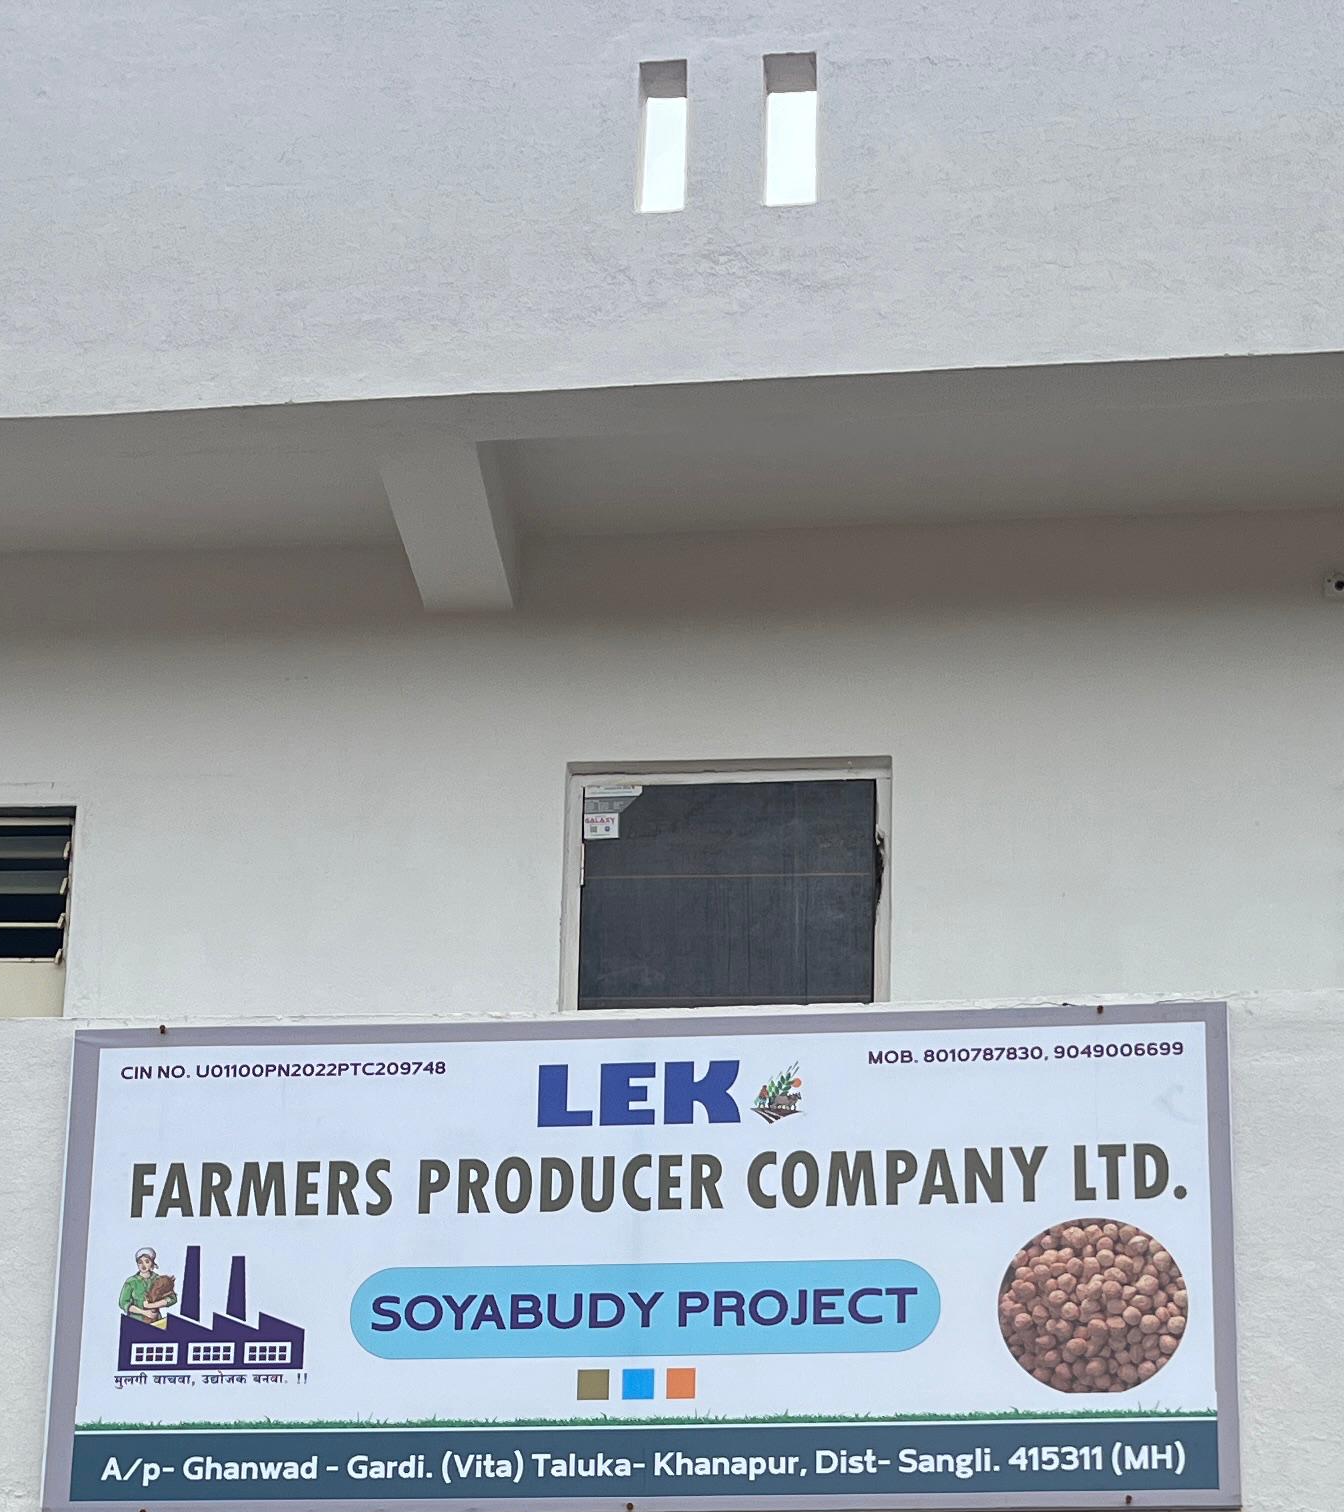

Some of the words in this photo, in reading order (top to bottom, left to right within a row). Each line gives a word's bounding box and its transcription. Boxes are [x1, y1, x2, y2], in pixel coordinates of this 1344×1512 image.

[120, 1065, 153, 1080] CIN
[157, 1064, 191, 1079] NO.
[196, 1061, 446, 1079] U01100PN2022PTC209748
[868, 1049, 919, 1065] MOB.
[923, 1045, 1049, 1063] 8010787830,
[1053, 1041, 1184, 1059] 9049006699
[537, 1060, 741, 1128] LEK
[130, 1158, 393, 1219] FARMERS
[417, 1154, 724, 1215] PRODUCER
[747, 1146, 1049, 1210] COMPANY
[1073, 1143, 1188, 1202] LTD.
[370, 1291, 665, 1332] SOYABUDY
[677, 1287, 919, 1328] PROJECT
[114, 1371, 148, 1389] मुलगी
[100, 1456, 175, 1487] A/p-
[182, 1455, 318, 1481] Ghanwad
[346, 1454, 433, 1480] Gardi.
[441, 1450, 524, 1484] (Vita)
[531, 1452, 646, 1478] Taluka-
[654, 1451, 808, 1481] Khanapur,
[815, 1448, 891, 1475] Dist-
[898, 1447, 1001, 1479] Sangli.
[1008, 1445, 1103, 1471] 415311
[1111, 1440, 1186, 1476] (MH)
